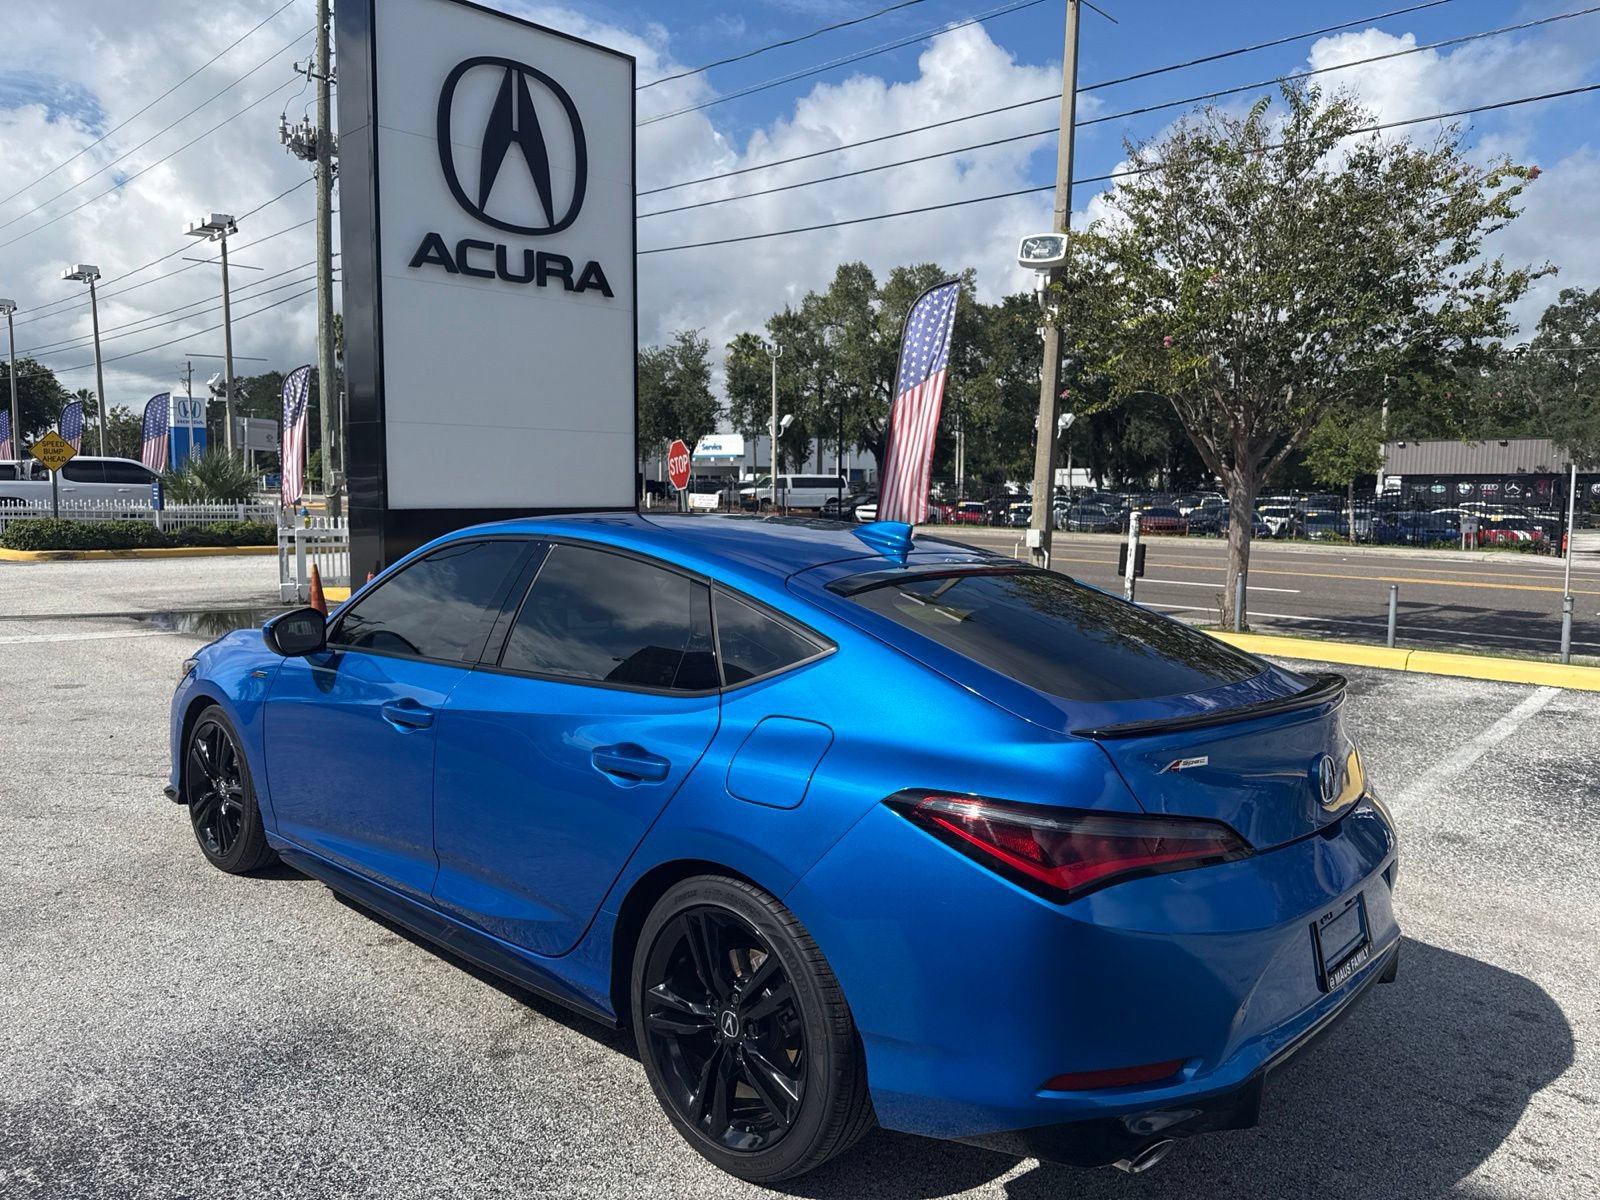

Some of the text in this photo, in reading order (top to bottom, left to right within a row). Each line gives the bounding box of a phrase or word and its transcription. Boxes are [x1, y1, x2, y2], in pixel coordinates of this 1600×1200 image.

[408, 232, 614, 298] ACURA
[702, 443, 722, 451] Service
[669, 454, 688, 476] STOP
[1334, 945, 1369, 986] MAUS FAMILY
